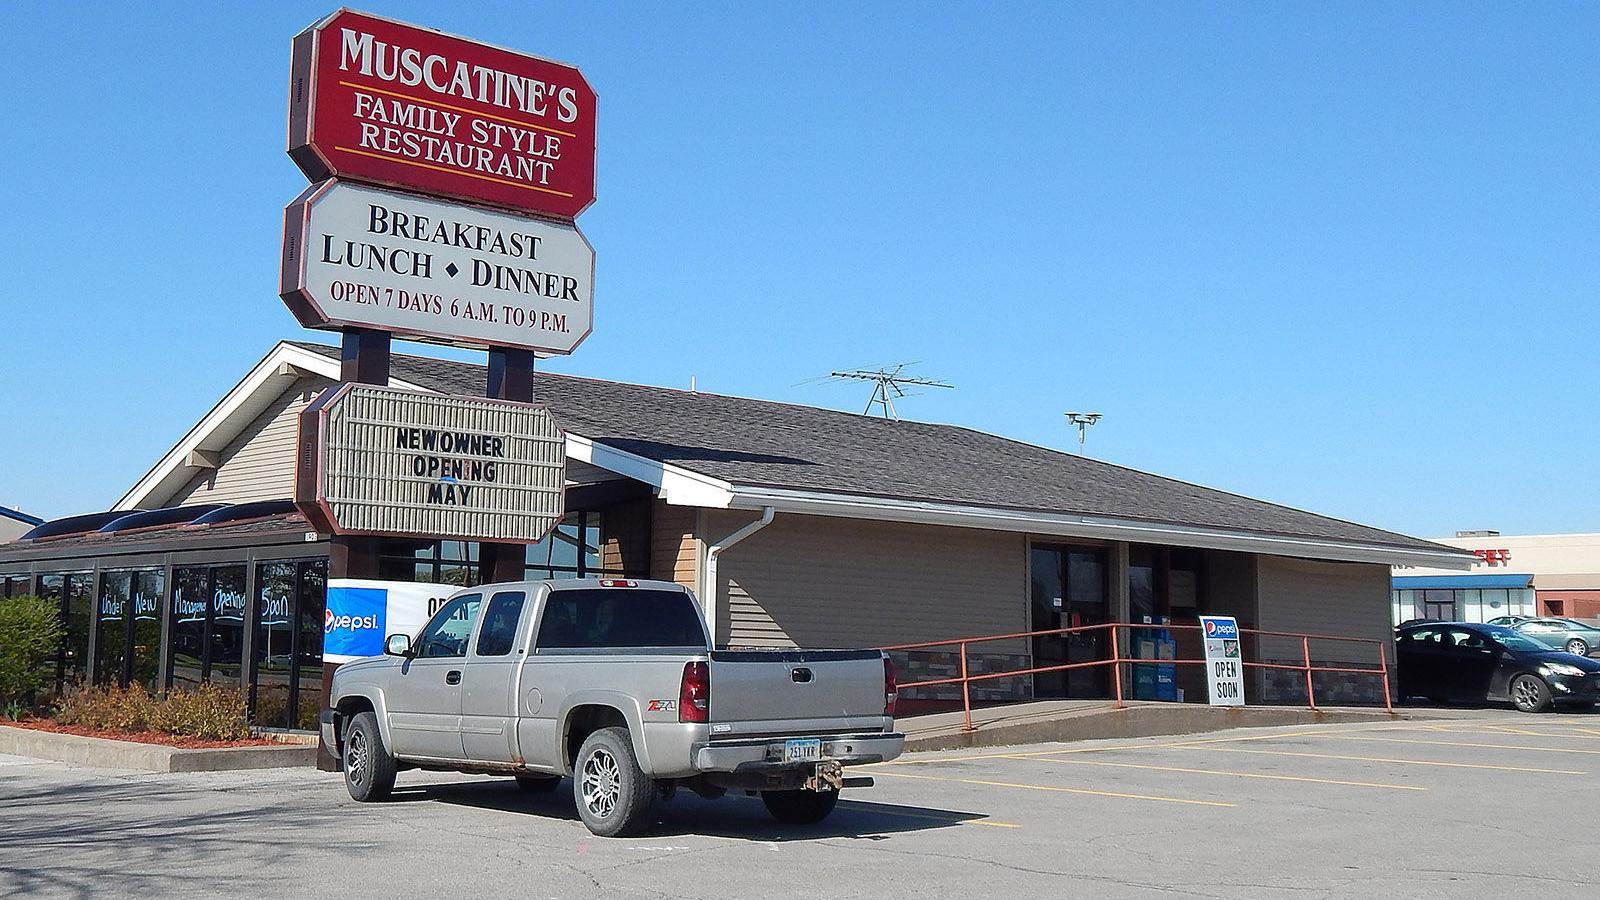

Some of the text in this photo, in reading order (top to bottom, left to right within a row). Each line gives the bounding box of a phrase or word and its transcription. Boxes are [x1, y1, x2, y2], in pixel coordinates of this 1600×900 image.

[338, 27, 578, 123] MUSCATINE'S
[353, 92, 561, 160] FAMILY STYLE
[359, 122, 554, 185] RESTAURANT
[367, 204, 542, 260] BREAKFAST
[321, 234, 580, 301] LUNCH DINNER
[330, 280, 570, 333] OPEN 7 DAYS 6 A.M. TO 9 P.M.
[413, 455, 496, 482] OPENING
[427, 484, 472, 506] MAY
[102, 594, 126, 615] Under
[135, 592, 157, 614] New
[214, 589, 246, 616] Opening
[262, 587, 289, 616] Soon
[333, 614, 376, 631] pepsi
[1217, 624, 1236, 635] pepsi
[1215, 661, 1237, 678] OPEN
[1217, 682, 1238, 698] SOON
